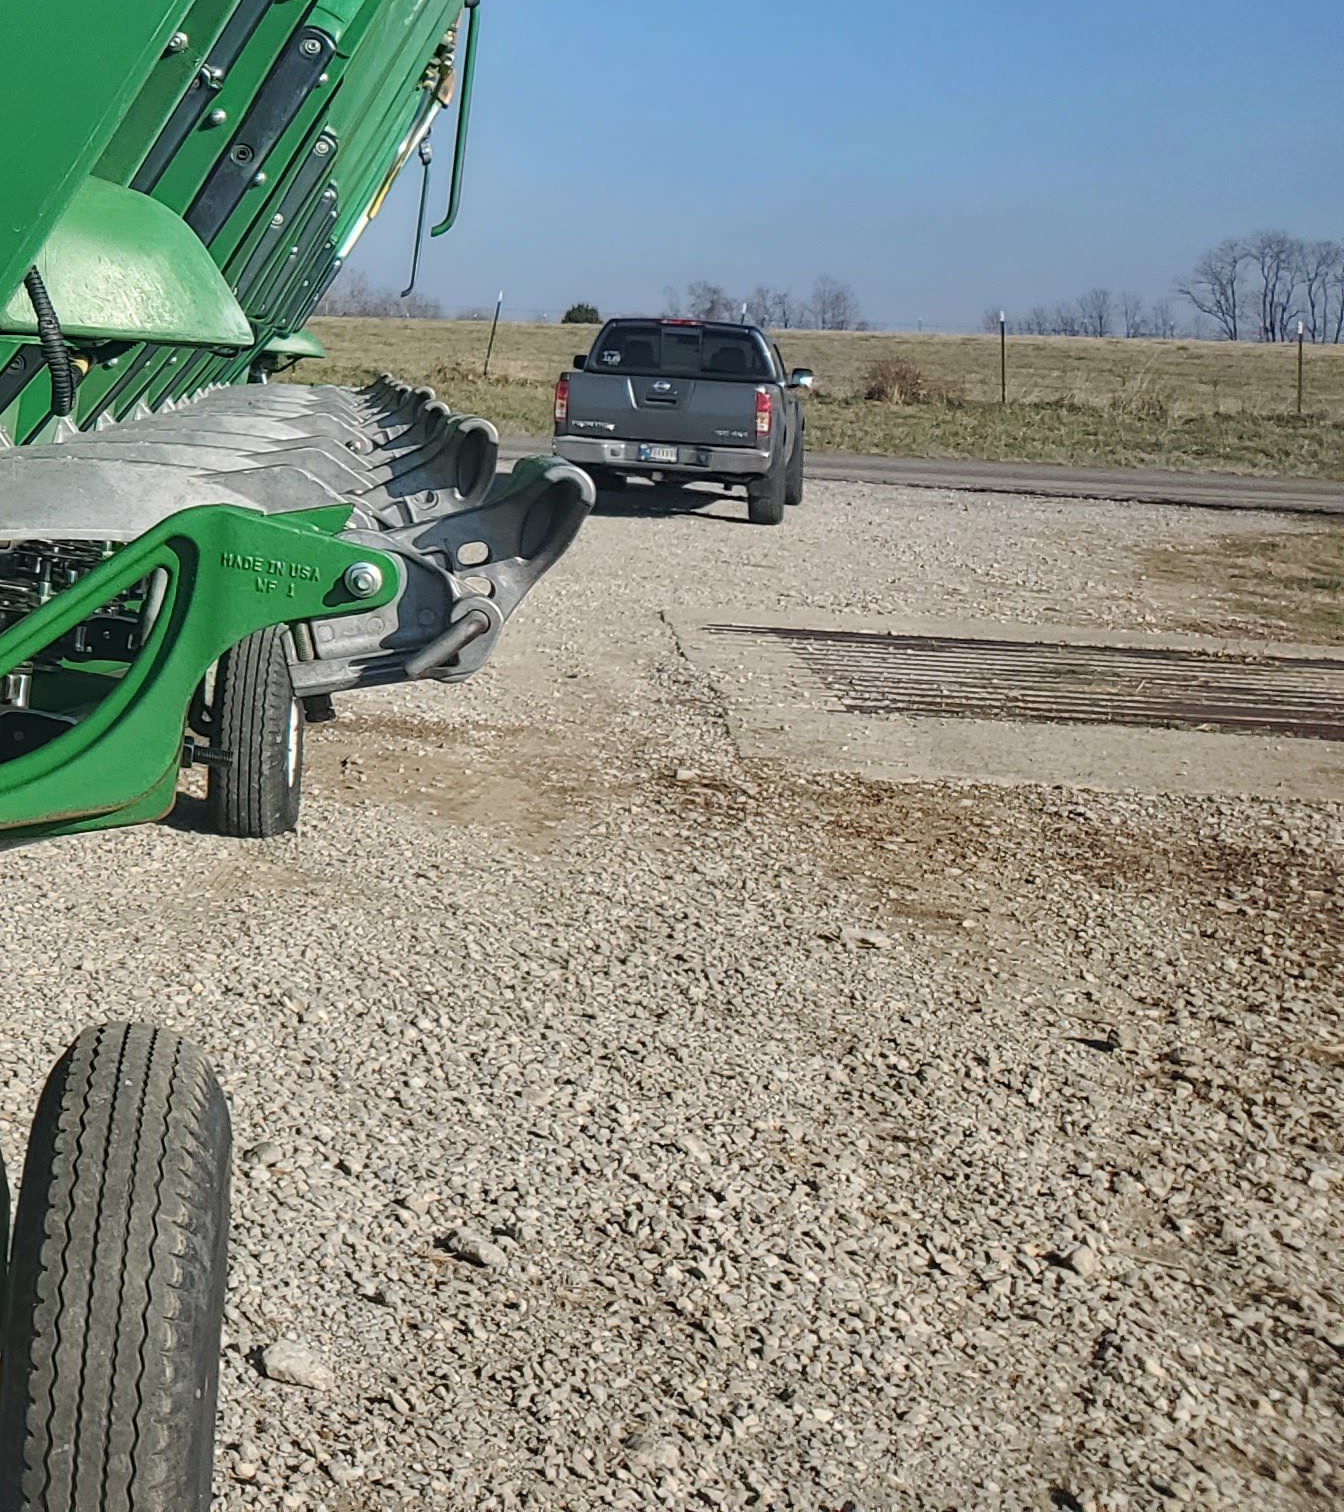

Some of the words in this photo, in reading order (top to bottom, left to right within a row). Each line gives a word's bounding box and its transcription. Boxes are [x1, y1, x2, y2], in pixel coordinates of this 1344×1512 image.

[221, 552, 264, 572] MADE
[267, 560, 286, 576] IN
[289, 563, 321, 582] USA
